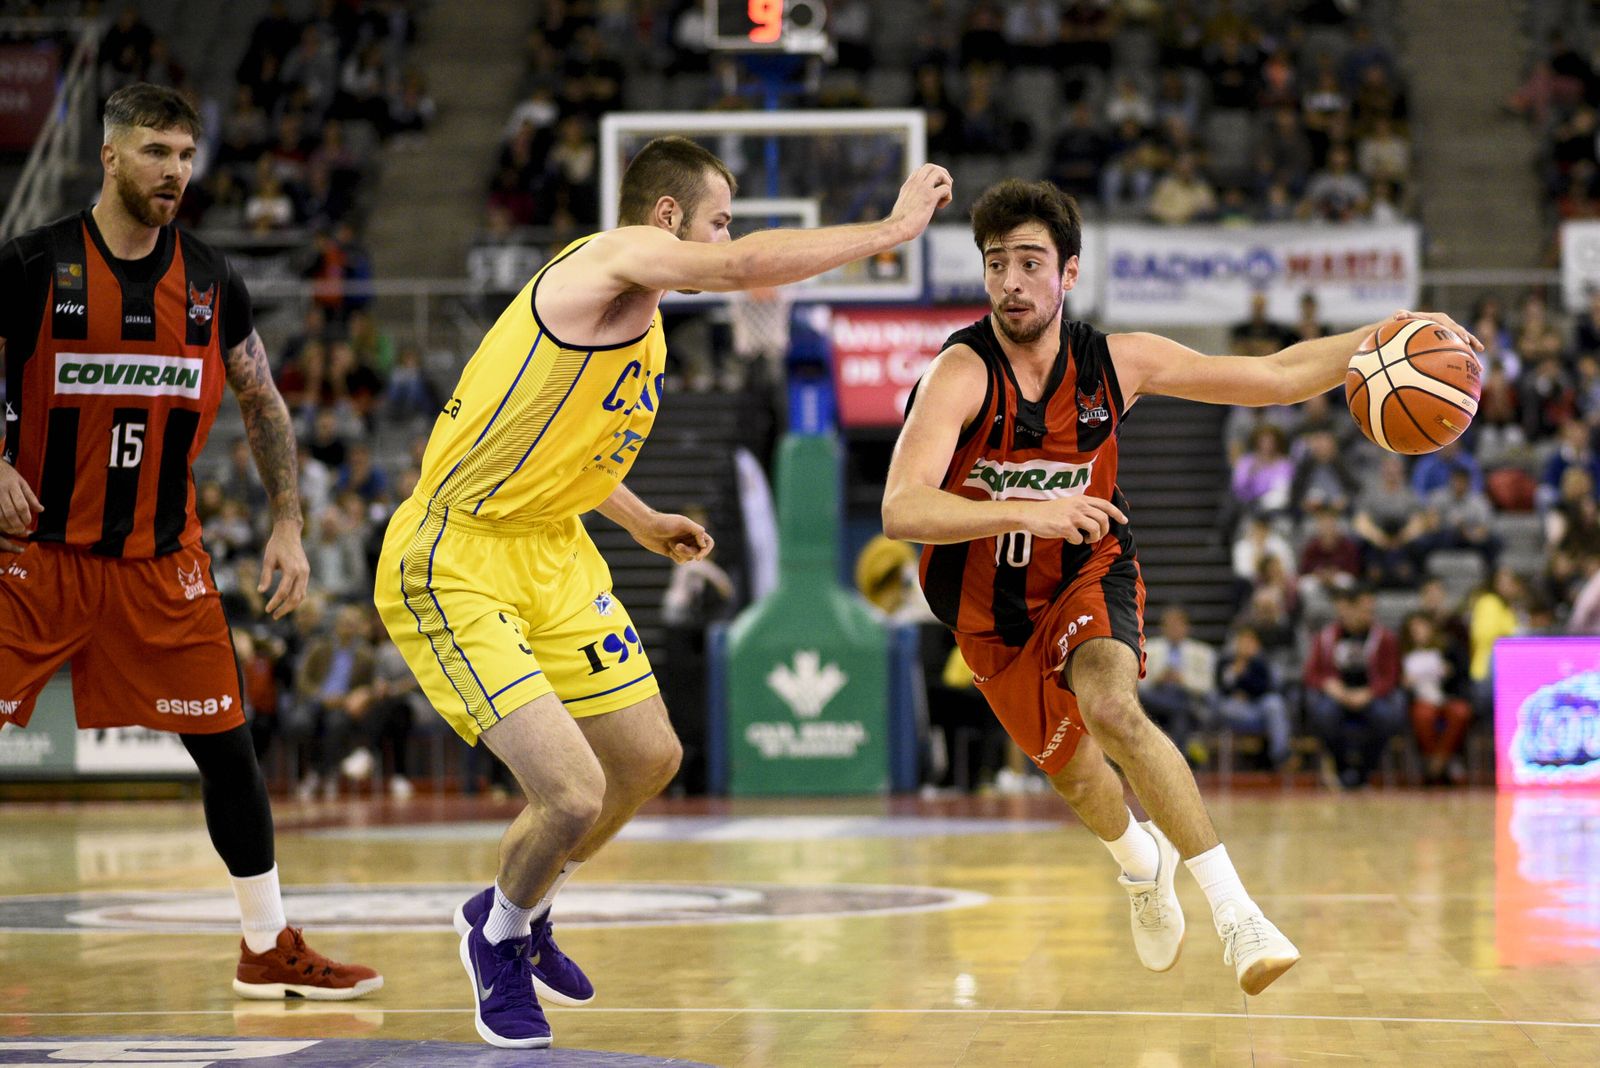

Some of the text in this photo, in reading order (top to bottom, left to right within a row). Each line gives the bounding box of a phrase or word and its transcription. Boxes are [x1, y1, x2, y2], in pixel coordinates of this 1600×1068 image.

[747, 0, 784, 43] 9
[58, 362, 200, 389] COVIRAN
[108, 423, 146, 468] 15
[156, 698, 218, 716] asisa
